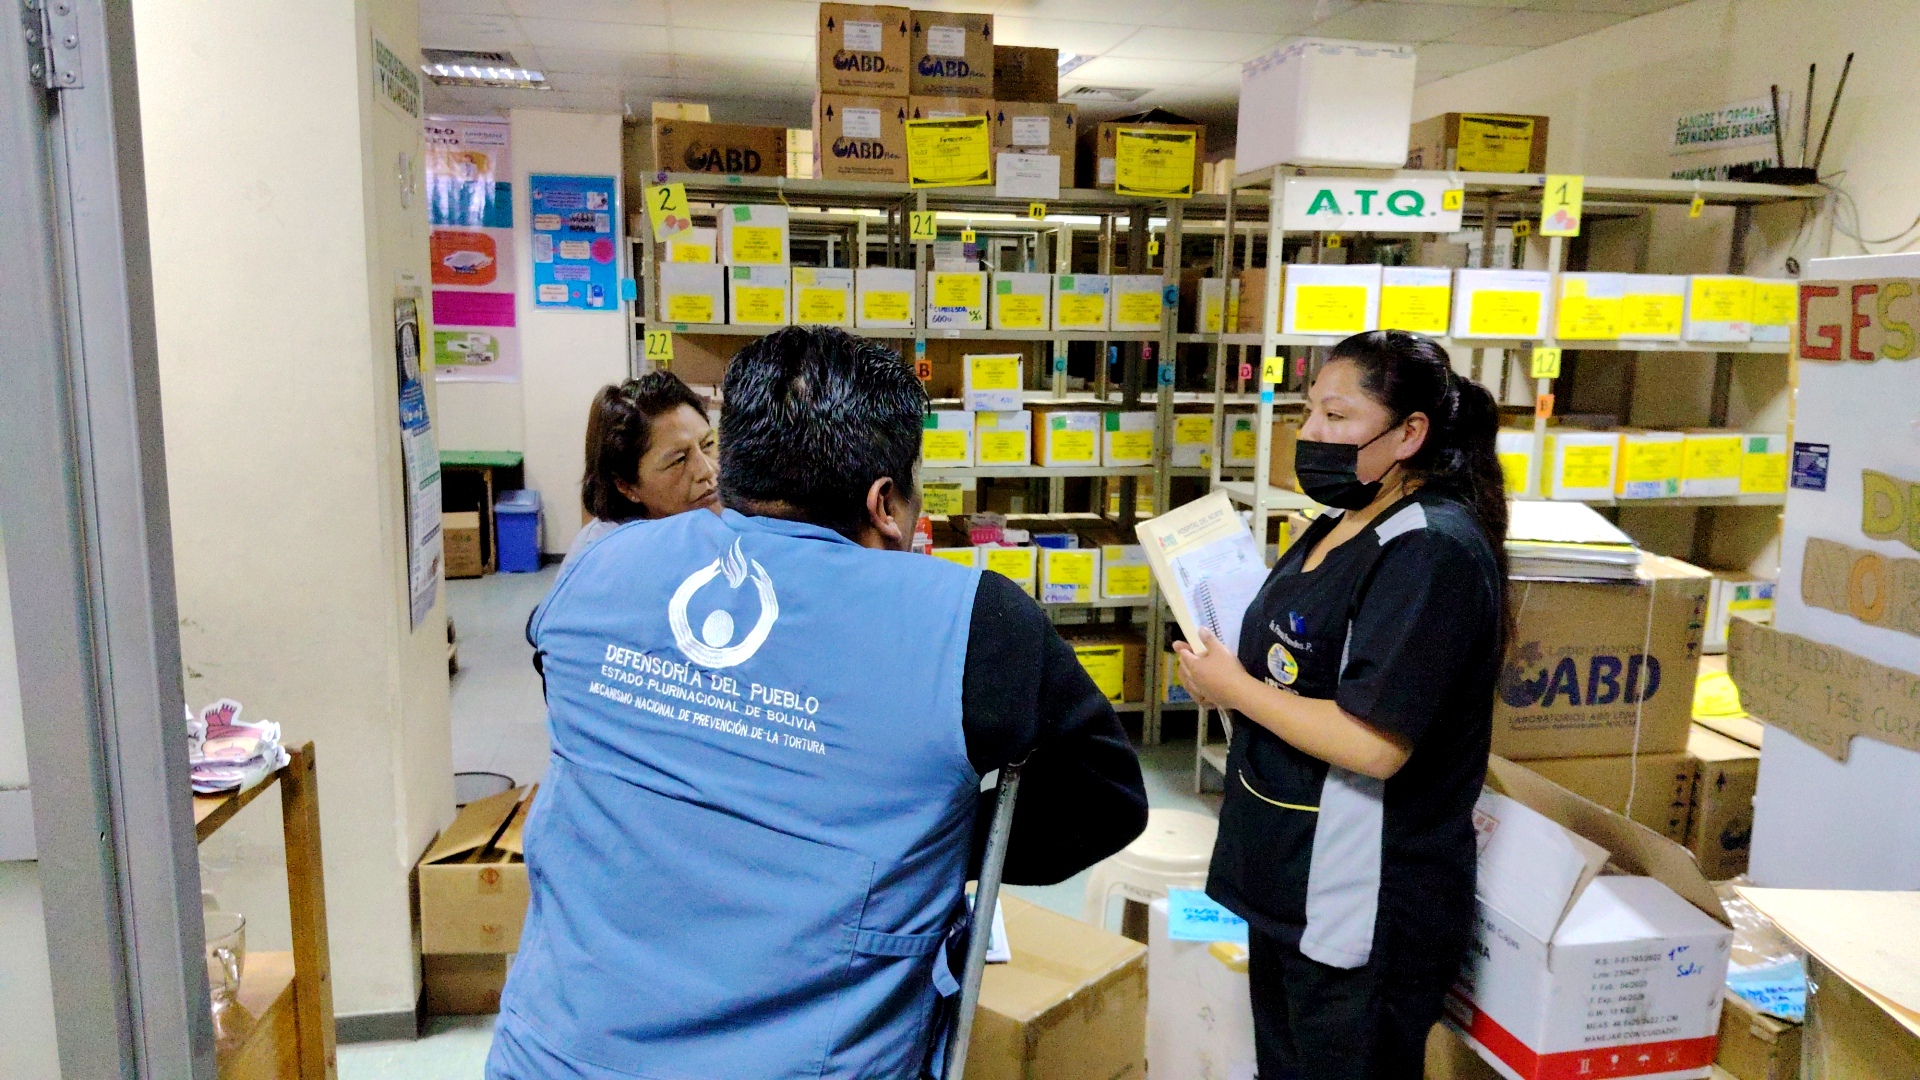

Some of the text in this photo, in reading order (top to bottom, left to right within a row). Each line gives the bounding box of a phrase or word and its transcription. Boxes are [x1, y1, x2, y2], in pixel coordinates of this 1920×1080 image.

[848, 54, 885, 73] ABD
[932, 60, 970, 78] ABD
[705, 148, 761, 173] ABD
[845, 141, 884, 160] ABD
[659, 187, 677, 211] 2
[1305, 189, 1437, 217] A.T.Q.
[1555, 182, 1570, 206] 1
[1799, 282, 1920, 361] GES
[919, 362, 930, 378] B
[1241, 366, 1250, 378] D
[1265, 365, 1274, 377] A
[605, 644, 819, 715] DEFENSORÍA DEL PUEBLO
[1540, 654, 1661, 708] ABD
[601, 664, 817, 732] ESTADO PLURINACIONAL DE BOLIVIA
[589, 681, 826, 755] MECANISMO NACIONAL DE PREVENCIÓN DE LA TORTURA
[1584, 1033, 1622, 1043] MANEJAR
[1624, 1031, 1640, 1039] CON
